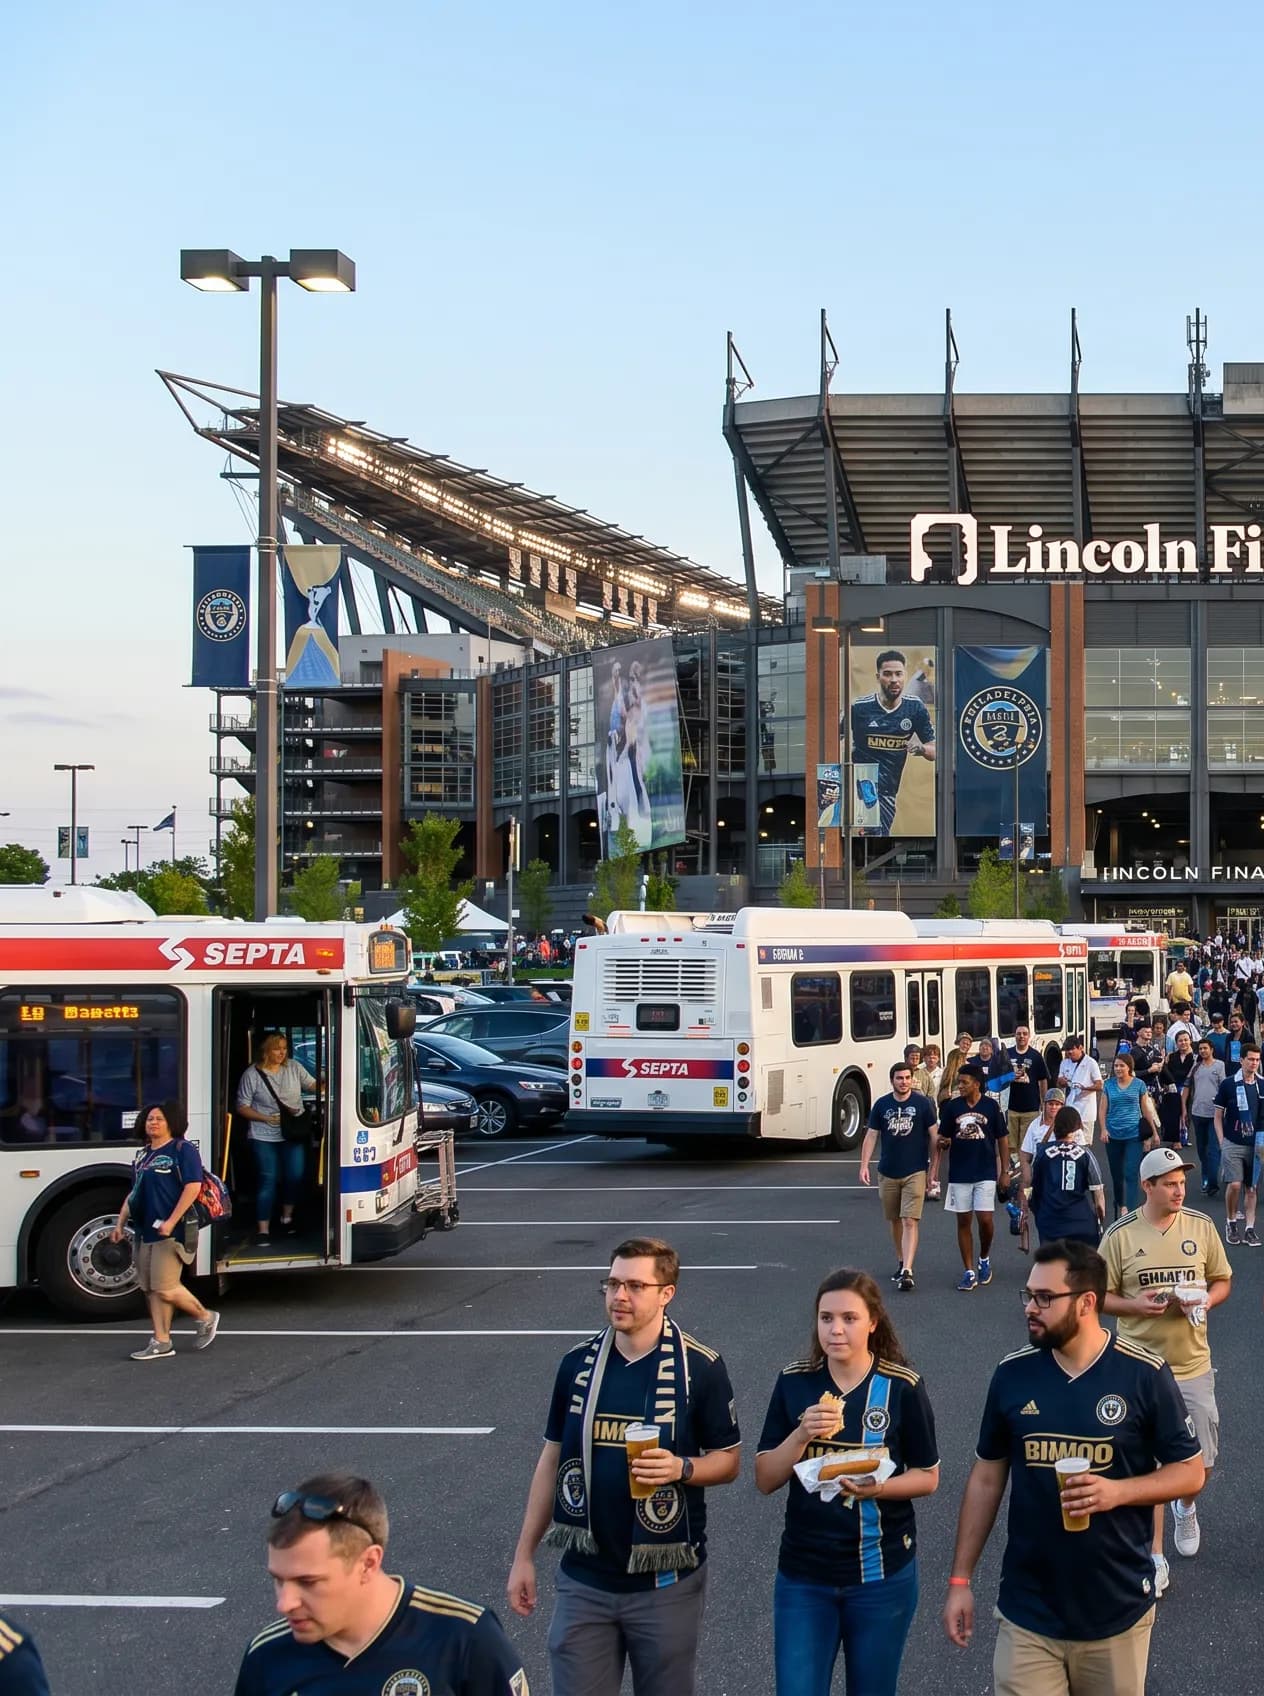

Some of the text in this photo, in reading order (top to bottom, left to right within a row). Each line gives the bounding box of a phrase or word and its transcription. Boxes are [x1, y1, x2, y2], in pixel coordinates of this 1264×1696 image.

[989, 523, 1199, 573] Lincoln
[203, 942, 305, 965] SEPTA
[640, 1062, 689, 1076] SEPTA
